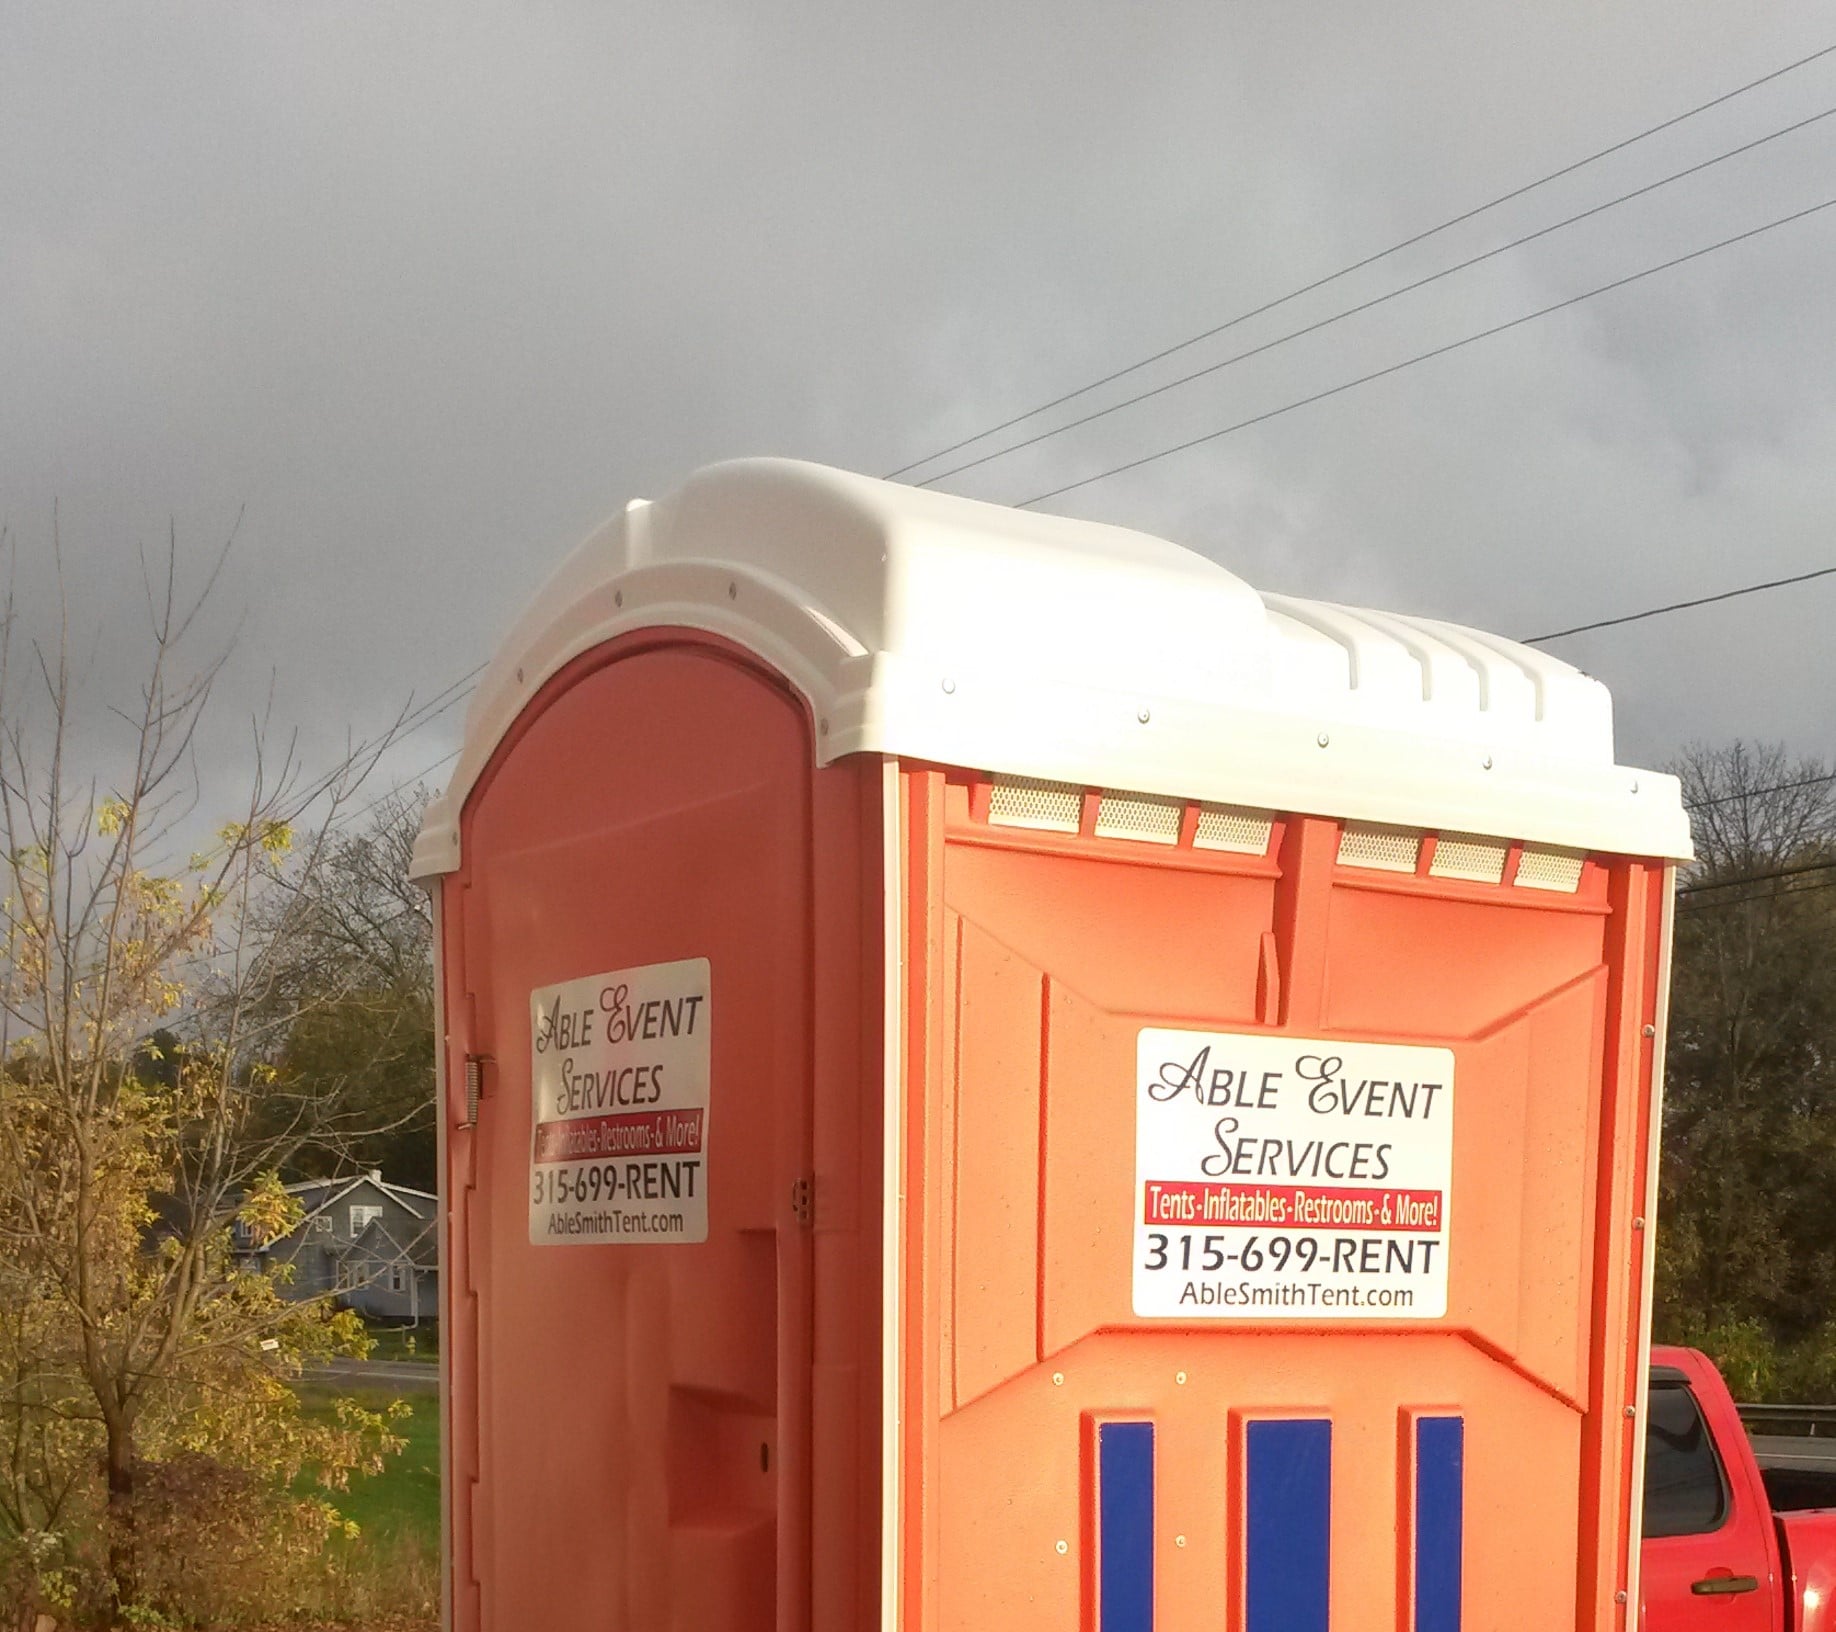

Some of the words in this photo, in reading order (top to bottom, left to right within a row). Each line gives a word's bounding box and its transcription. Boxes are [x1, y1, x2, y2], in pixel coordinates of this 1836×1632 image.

[599, 984, 704, 1044] EVENT
[557, 1057, 664, 1116] SERVICES
[1148, 1045, 1283, 1109] ABLE
[1295, 1055, 1443, 1120] EVENT
[1200, 1117, 1393, 1181] SERVICES
[533, 1160, 701, 1205] 315-699-RENT
[548, 1210, 684, 1235] AbleSmithTent.com
[1395, 1193, 1438, 1226] More!
[1144, 1233, 1440, 1274] 315-699-RENT
[1179, 1281, 1414, 1307] AbleSmithTent.com
